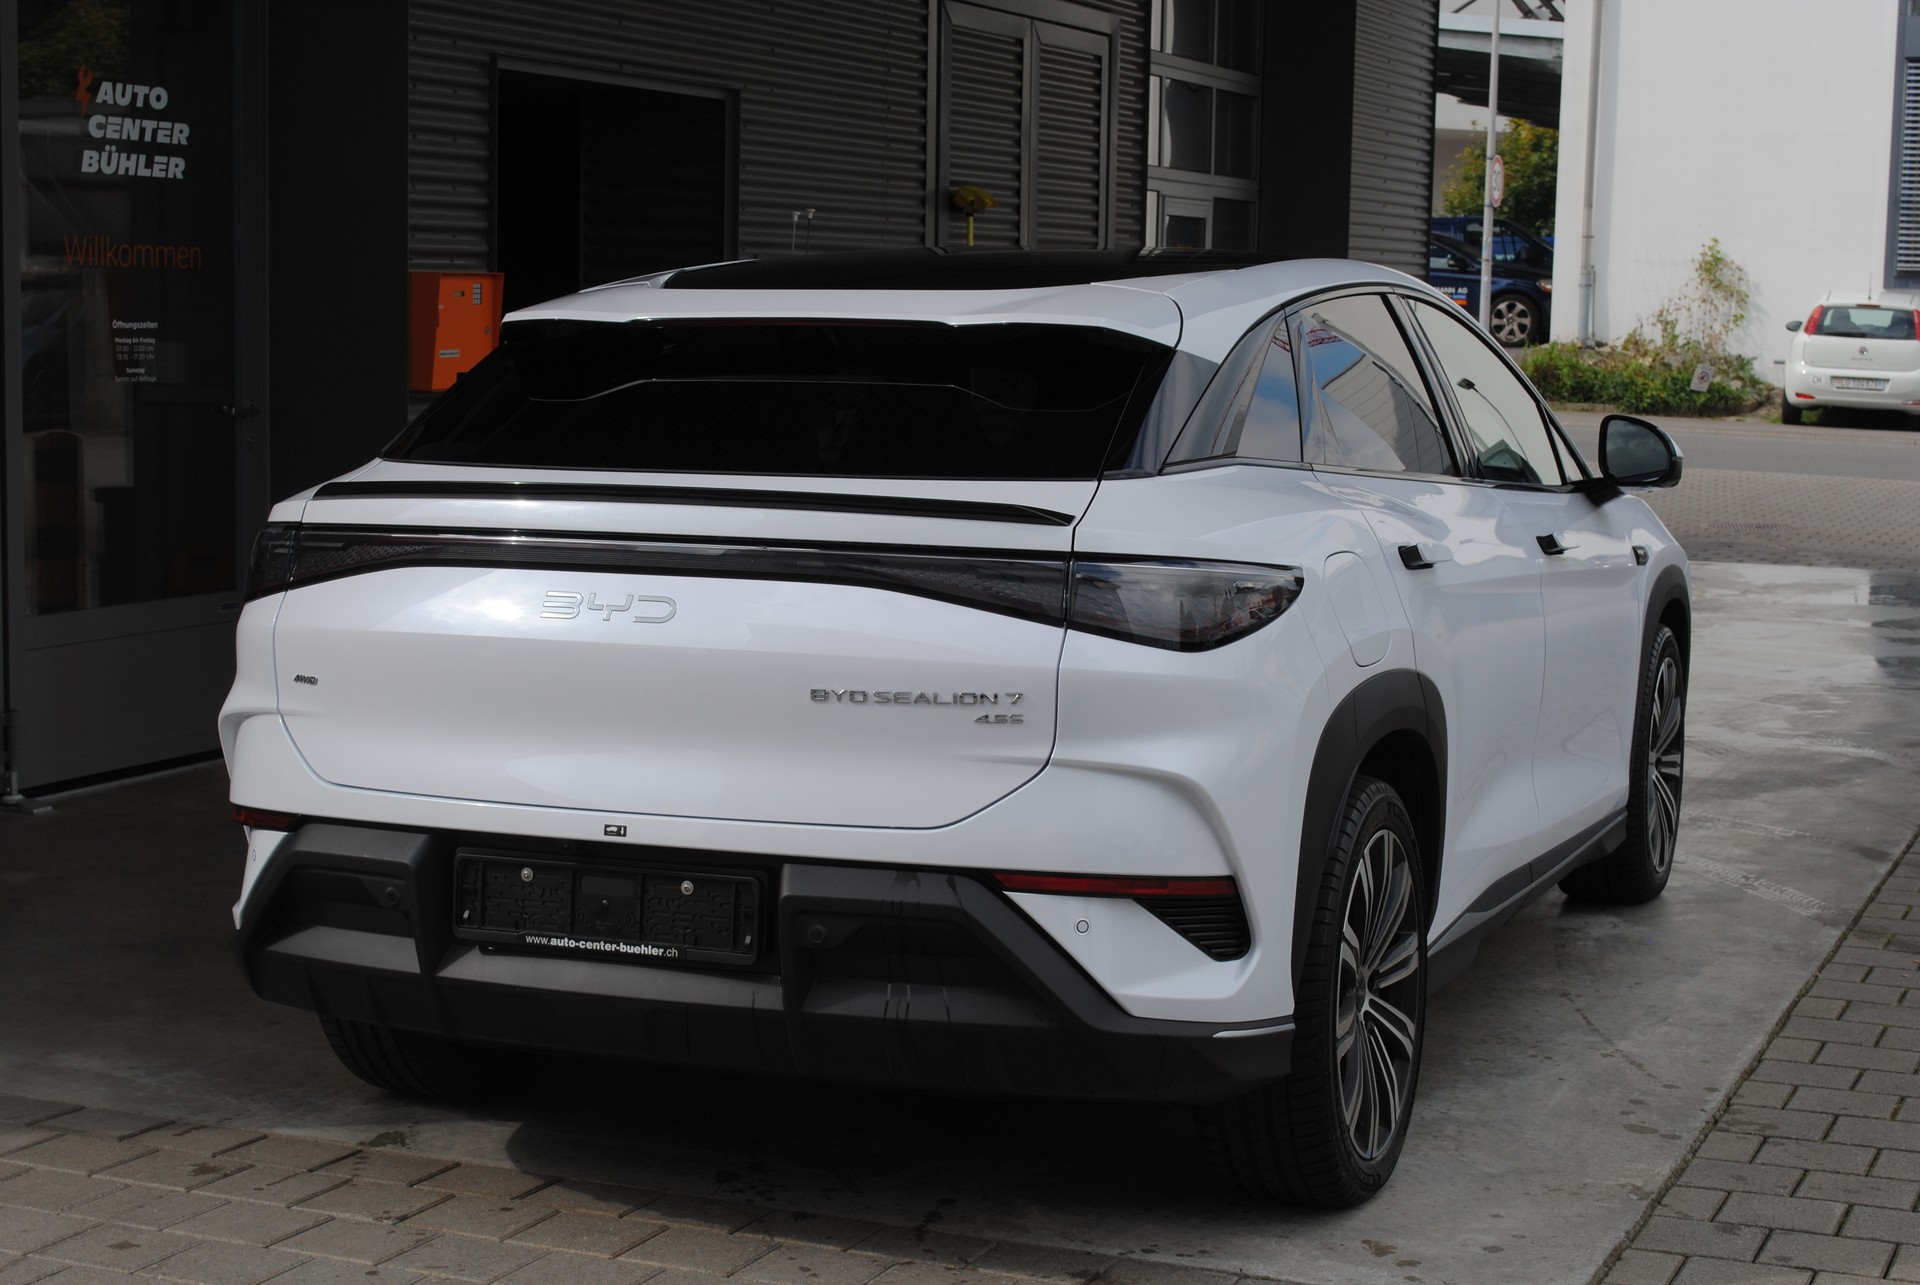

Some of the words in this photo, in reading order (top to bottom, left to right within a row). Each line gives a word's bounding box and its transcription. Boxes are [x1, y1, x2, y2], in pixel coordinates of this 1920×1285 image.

[95, 81, 168, 110] AUTO
[88, 114, 190, 146] CENTER
[81, 144, 186, 179] BÜHLER
[63, 234, 202, 269] Willkommen
[112, 319, 158, 330] Öffnungszeiten
[540, 590, 678, 624] BYD
[293, 674, 318, 686] AWD
[810, 688, 868, 703] BYD
[872, 690, 998, 705] SEALION
[1004, 692, 1024, 705] 7
[525, 935, 678, 958] www.auto-center-buehler.ch
